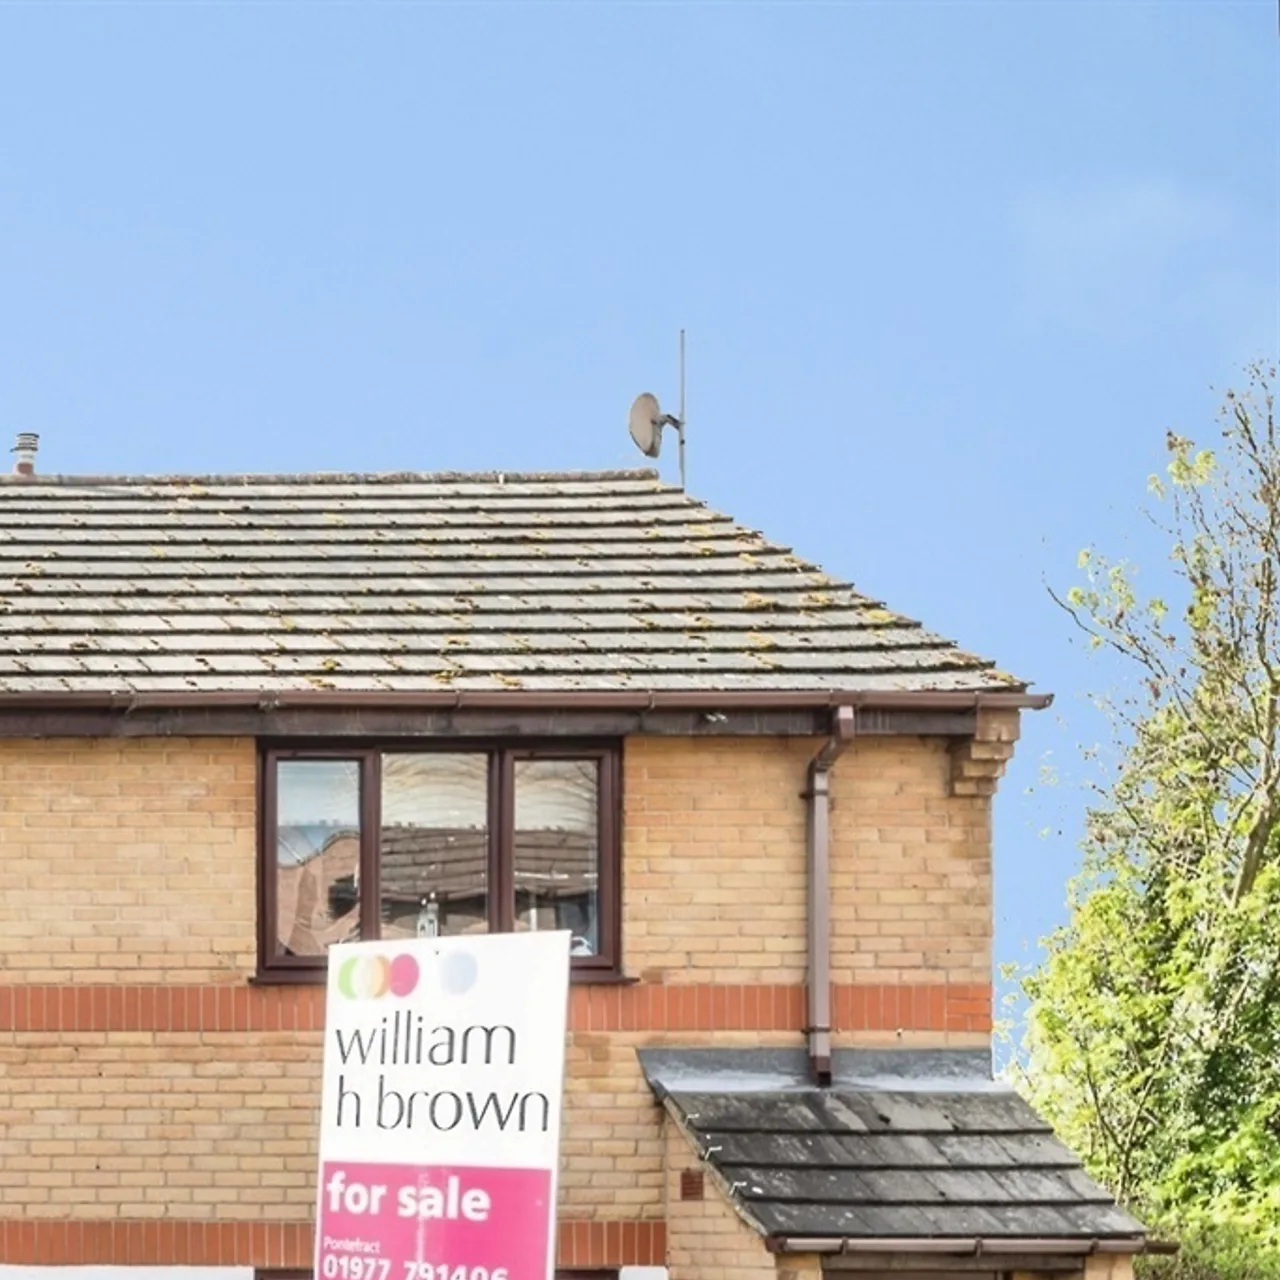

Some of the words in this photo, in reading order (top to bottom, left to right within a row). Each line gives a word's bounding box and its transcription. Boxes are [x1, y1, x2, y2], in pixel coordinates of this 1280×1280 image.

[335, 1009, 516, 1066] william
[336, 1074, 361, 1128] h
[376, 1074, 549, 1132] brown
[326, 1170, 388, 1215] for
[397, 1175, 491, 1222] sale
[324, 1235, 380, 1254] Pontefract
